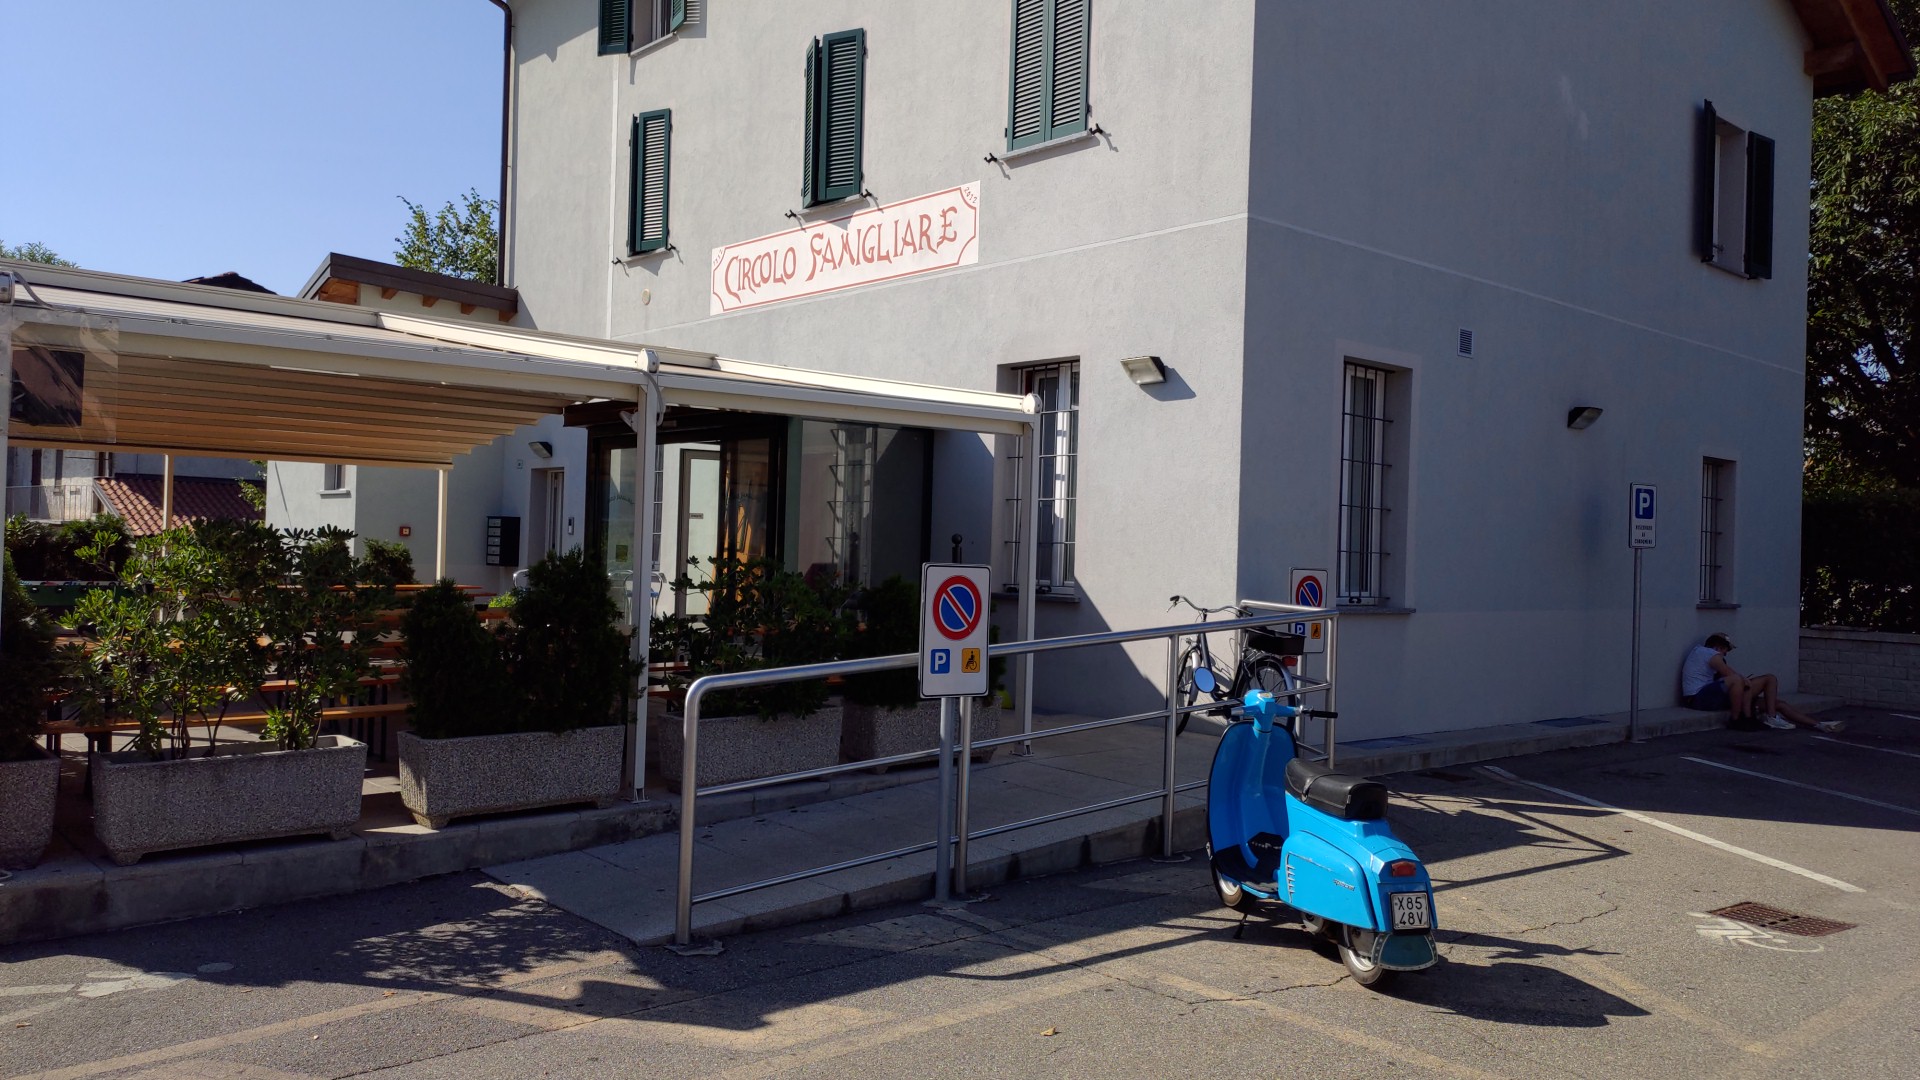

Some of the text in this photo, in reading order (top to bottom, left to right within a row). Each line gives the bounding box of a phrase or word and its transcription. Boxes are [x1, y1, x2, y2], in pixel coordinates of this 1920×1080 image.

[964, 187, 978, 204] 2012
[724, 206, 958, 304] CIRCOLO FAMIGLIARE
[1639, 492, 1651, 516] P
[934, 652, 947, 671] P
[1397, 896, 1423, 911] X85
[1399, 911, 1424, 926] 48V
